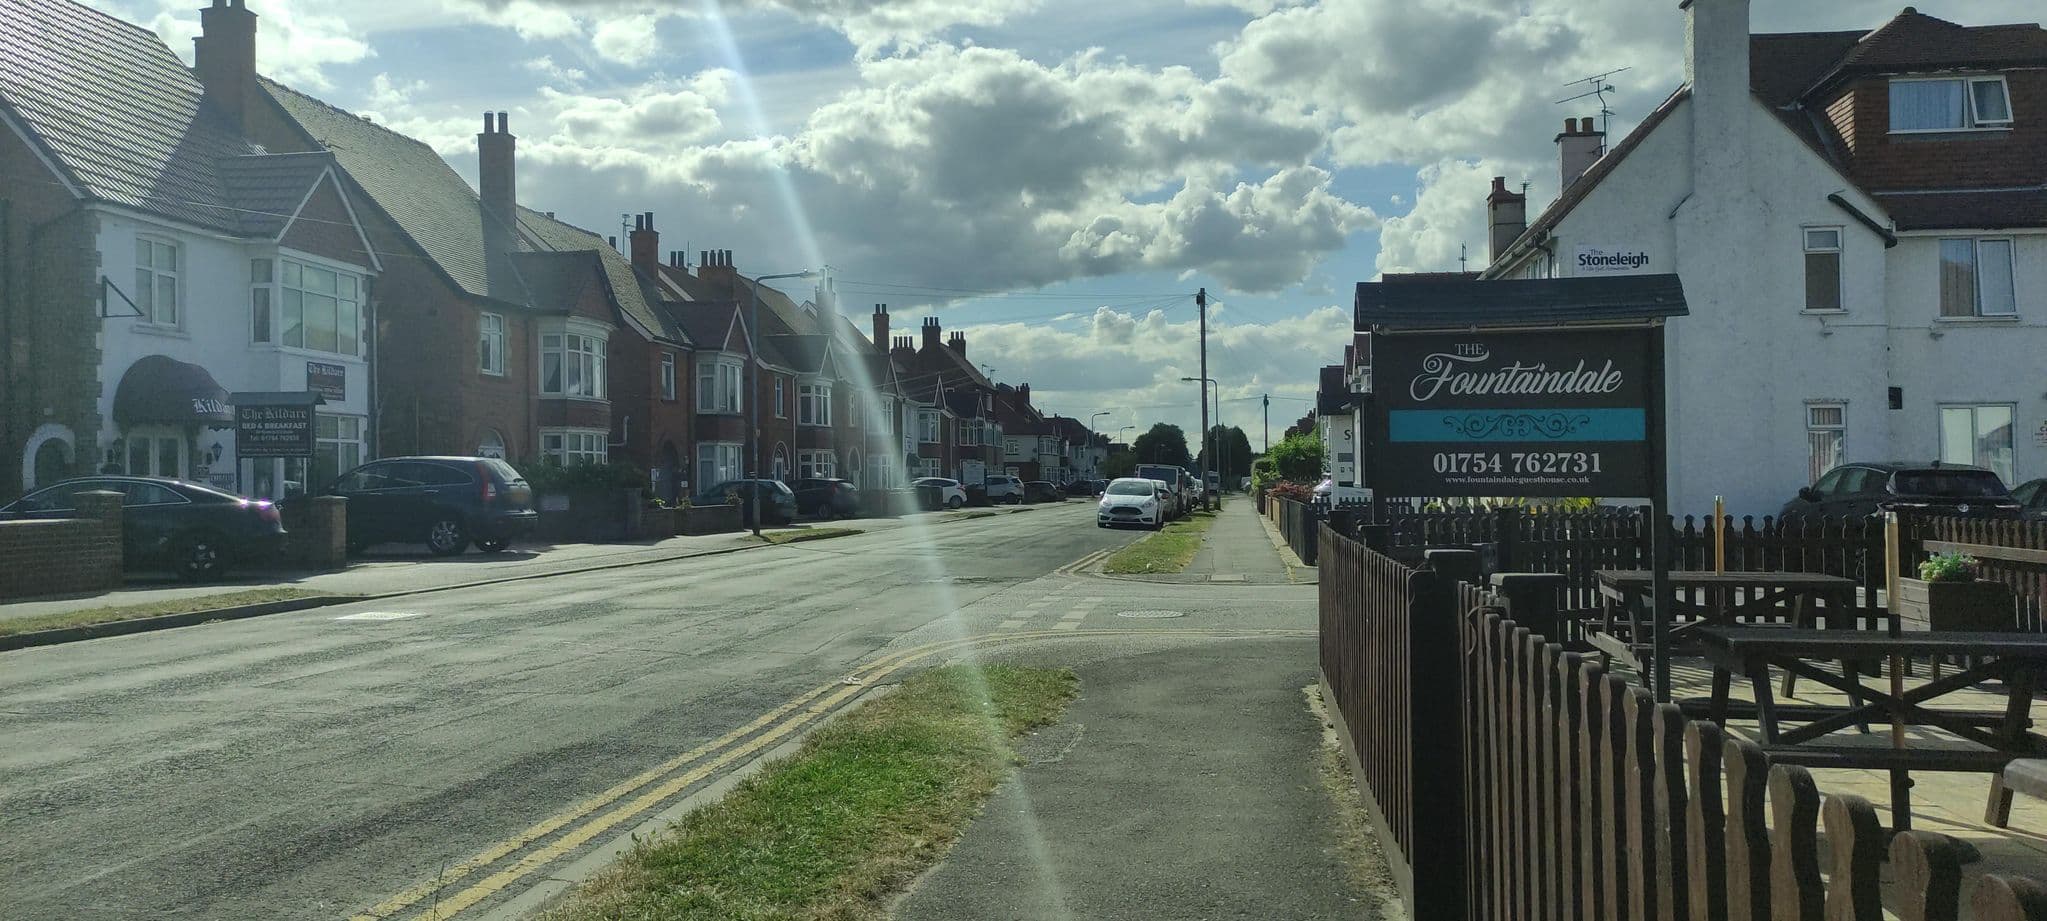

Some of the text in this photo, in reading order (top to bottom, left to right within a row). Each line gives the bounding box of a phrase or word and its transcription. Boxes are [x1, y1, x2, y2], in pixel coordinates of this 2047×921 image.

[1589, 248, 1604, 256] The
[1578, 252, 1649, 269] Stoneleigh
[1455, 343, 1484, 355] THE
[1409, 352, 1624, 402] Fountaindale
[241, 407, 307, 420] The Kildare
[242, 422, 307, 430] BED & BREAKFAST
[1433, 452, 1602, 473] 01754 762731
[1445, 475, 1590, 485] www.fountaindaleguesthouse.co.uk
